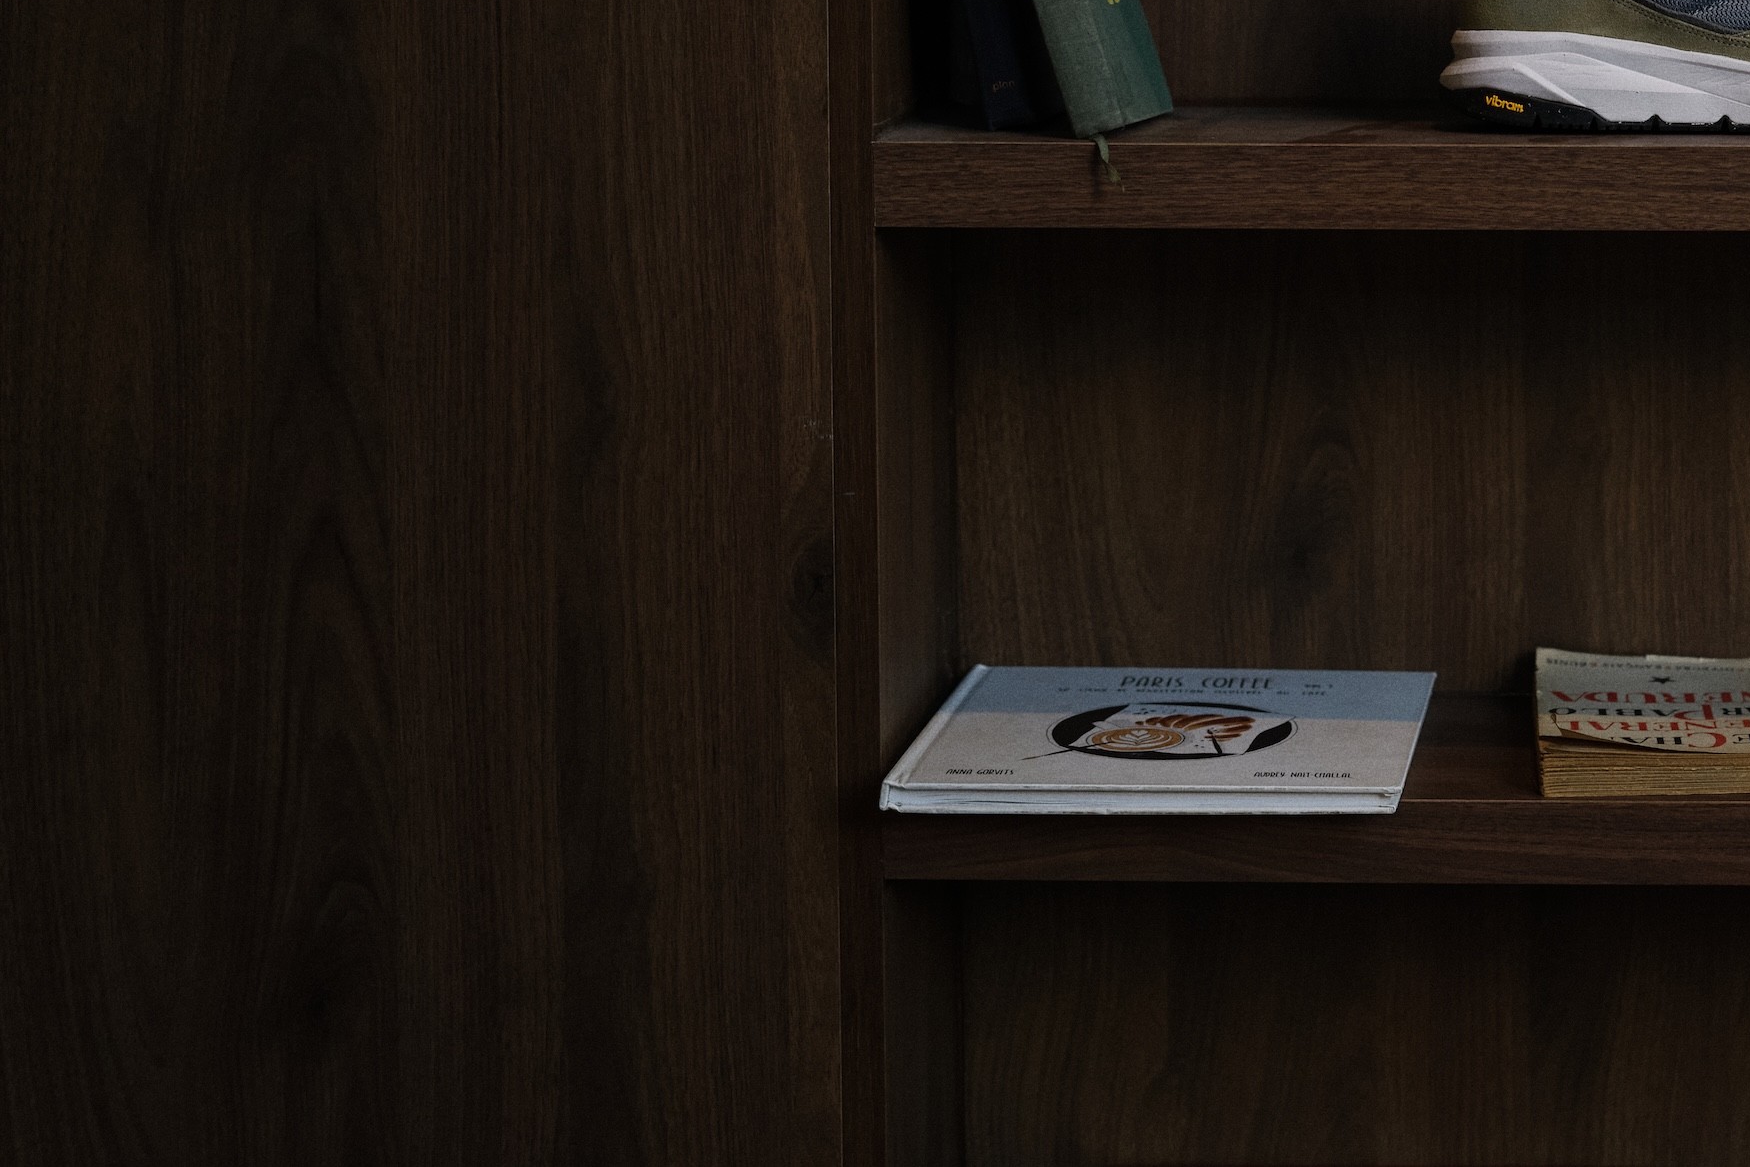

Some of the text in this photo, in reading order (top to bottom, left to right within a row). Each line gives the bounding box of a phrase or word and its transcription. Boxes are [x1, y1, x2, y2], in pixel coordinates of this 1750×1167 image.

[1485, 94, 1525, 113] vibram
[1121, 676, 1182, 687] PARIS
[1548, 704, 1714, 721] PABLO
